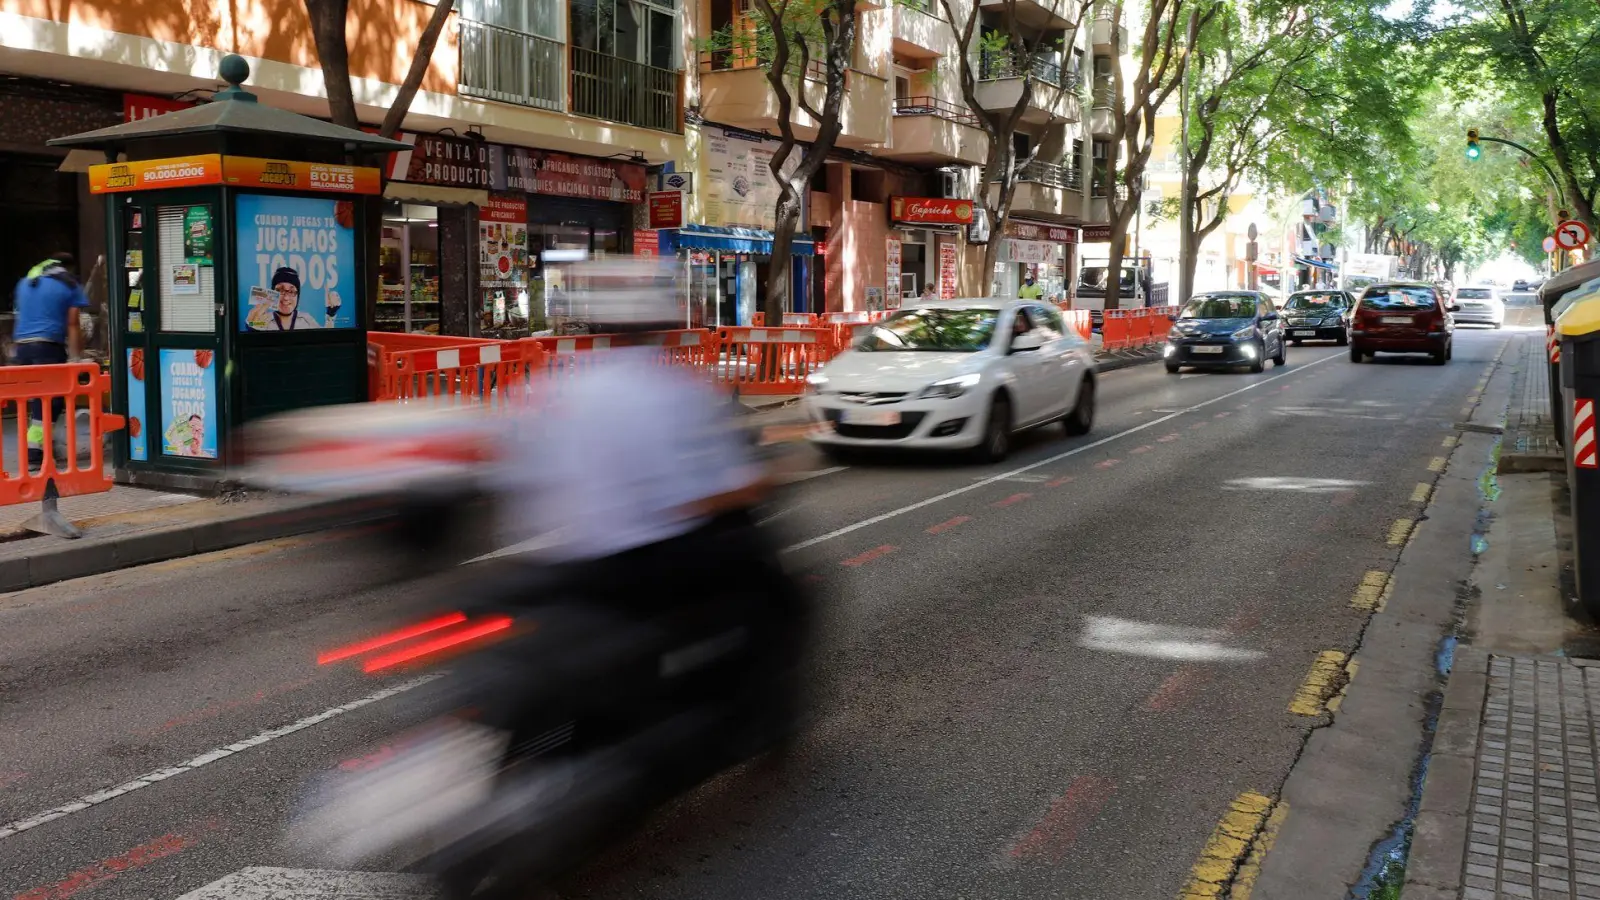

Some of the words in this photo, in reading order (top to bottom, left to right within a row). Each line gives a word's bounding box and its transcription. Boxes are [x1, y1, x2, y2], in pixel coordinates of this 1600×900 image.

[425, 139, 470, 161] VENTA
[479, 147, 495, 164] DE
[507, 155, 540, 170] LATINOS,
[541, 159, 582, 175] AFRICANOS,
[144, 167, 204, 181] 90.000.000€
[310, 171, 354, 184] BOTES
[425, 162, 496, 186] PRODUCTOS
[597, 186, 621, 199] FRUTOS
[622, 189, 641, 201] SECOS
[907, 203, 953, 218] Capricho
[254, 214, 288, 226] CUANDO
[291, 215, 322, 227] JUEGAS
[256, 227, 337, 253] JUGAMOS
[1049, 228, 1068, 240] COTON
[256, 253, 339, 290] TODOS
[171, 387, 206, 401] JUGAMOS
[172, 400, 206, 419] TODOS
